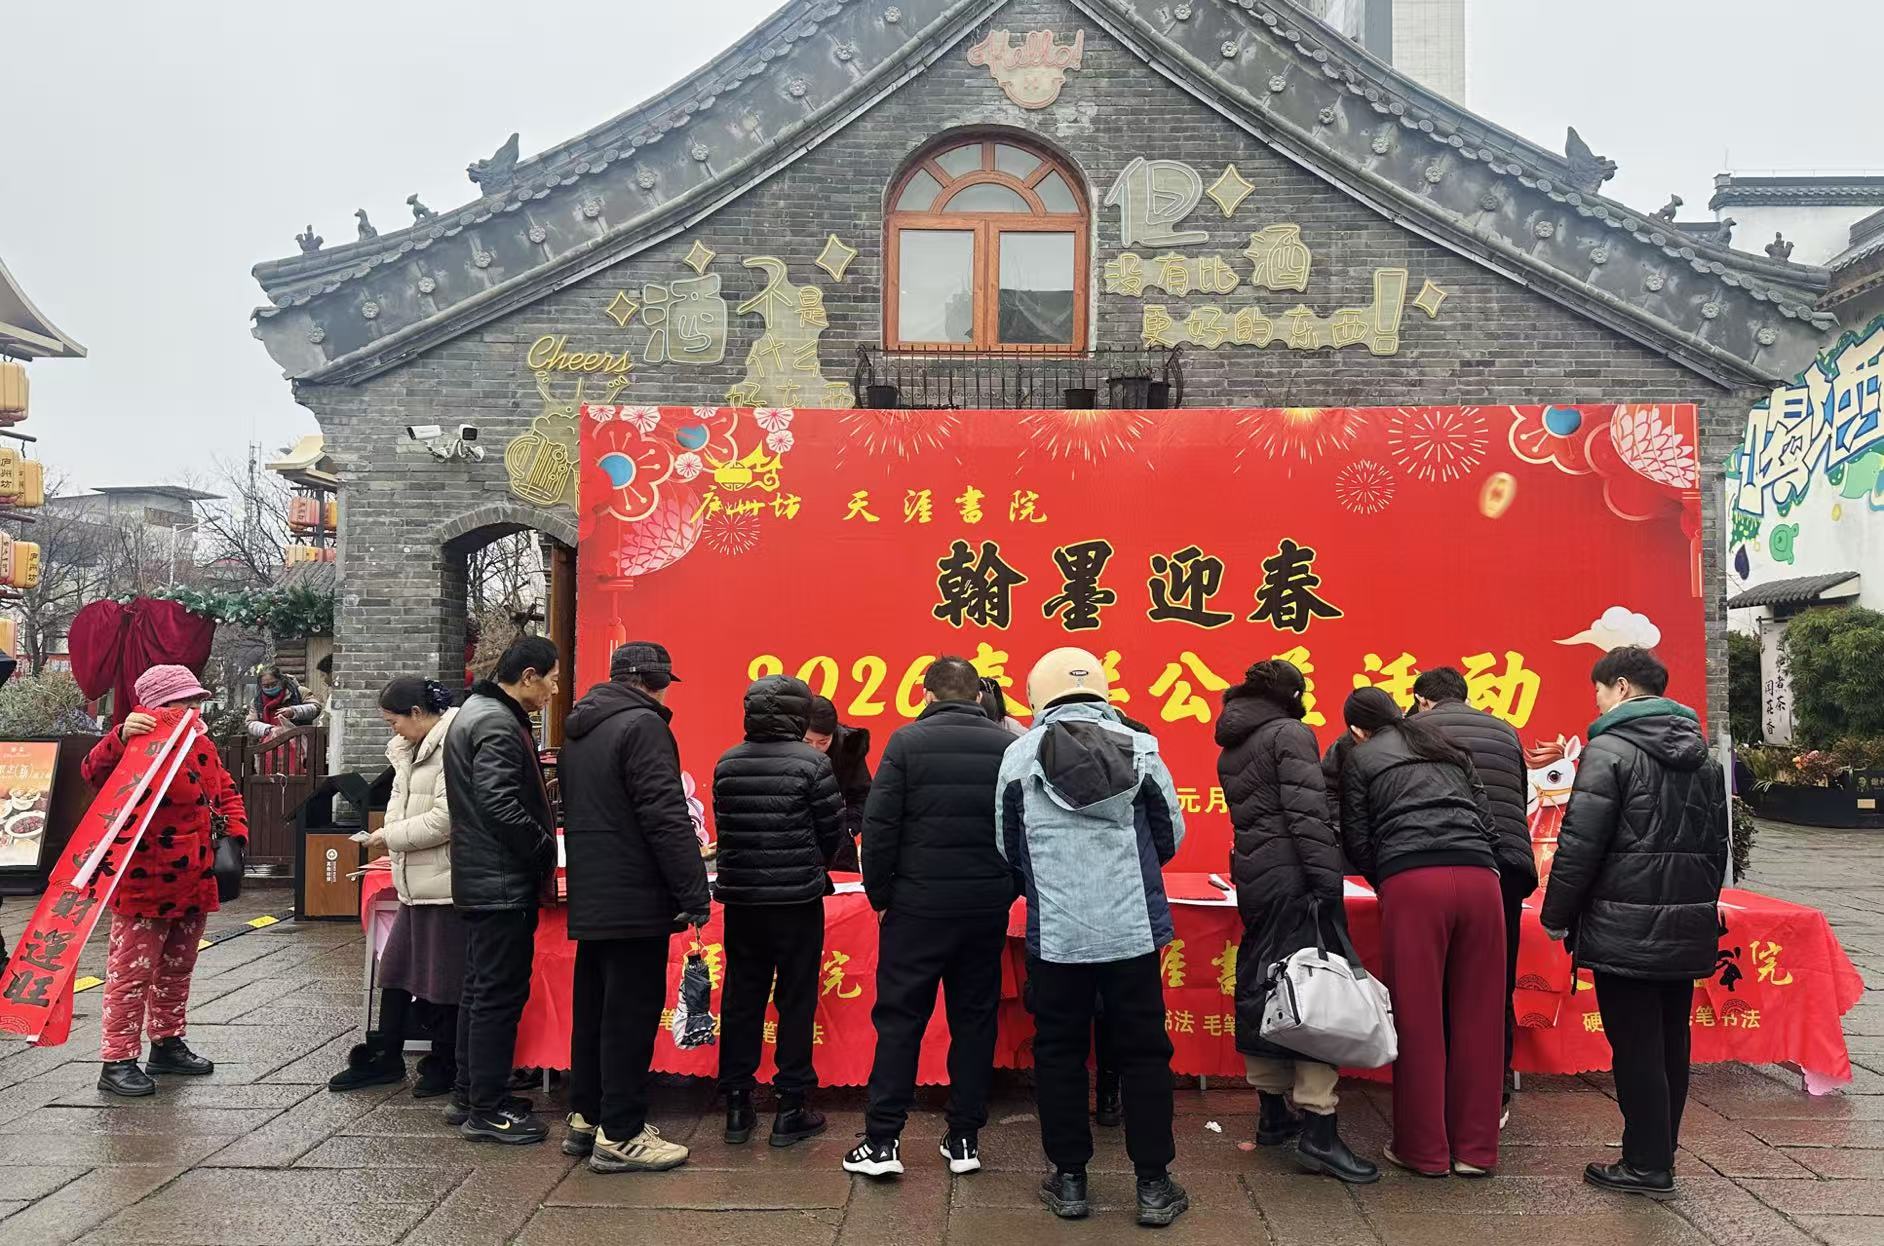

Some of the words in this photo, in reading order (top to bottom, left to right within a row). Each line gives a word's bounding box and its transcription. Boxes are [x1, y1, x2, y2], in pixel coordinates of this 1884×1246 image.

[967, 28, 1085, 78] Hello!
[1103, 156, 1210, 249] 但
[527, 334, 635, 375] Cheers
[932, 537, 1345, 634] 翰墨迎春
